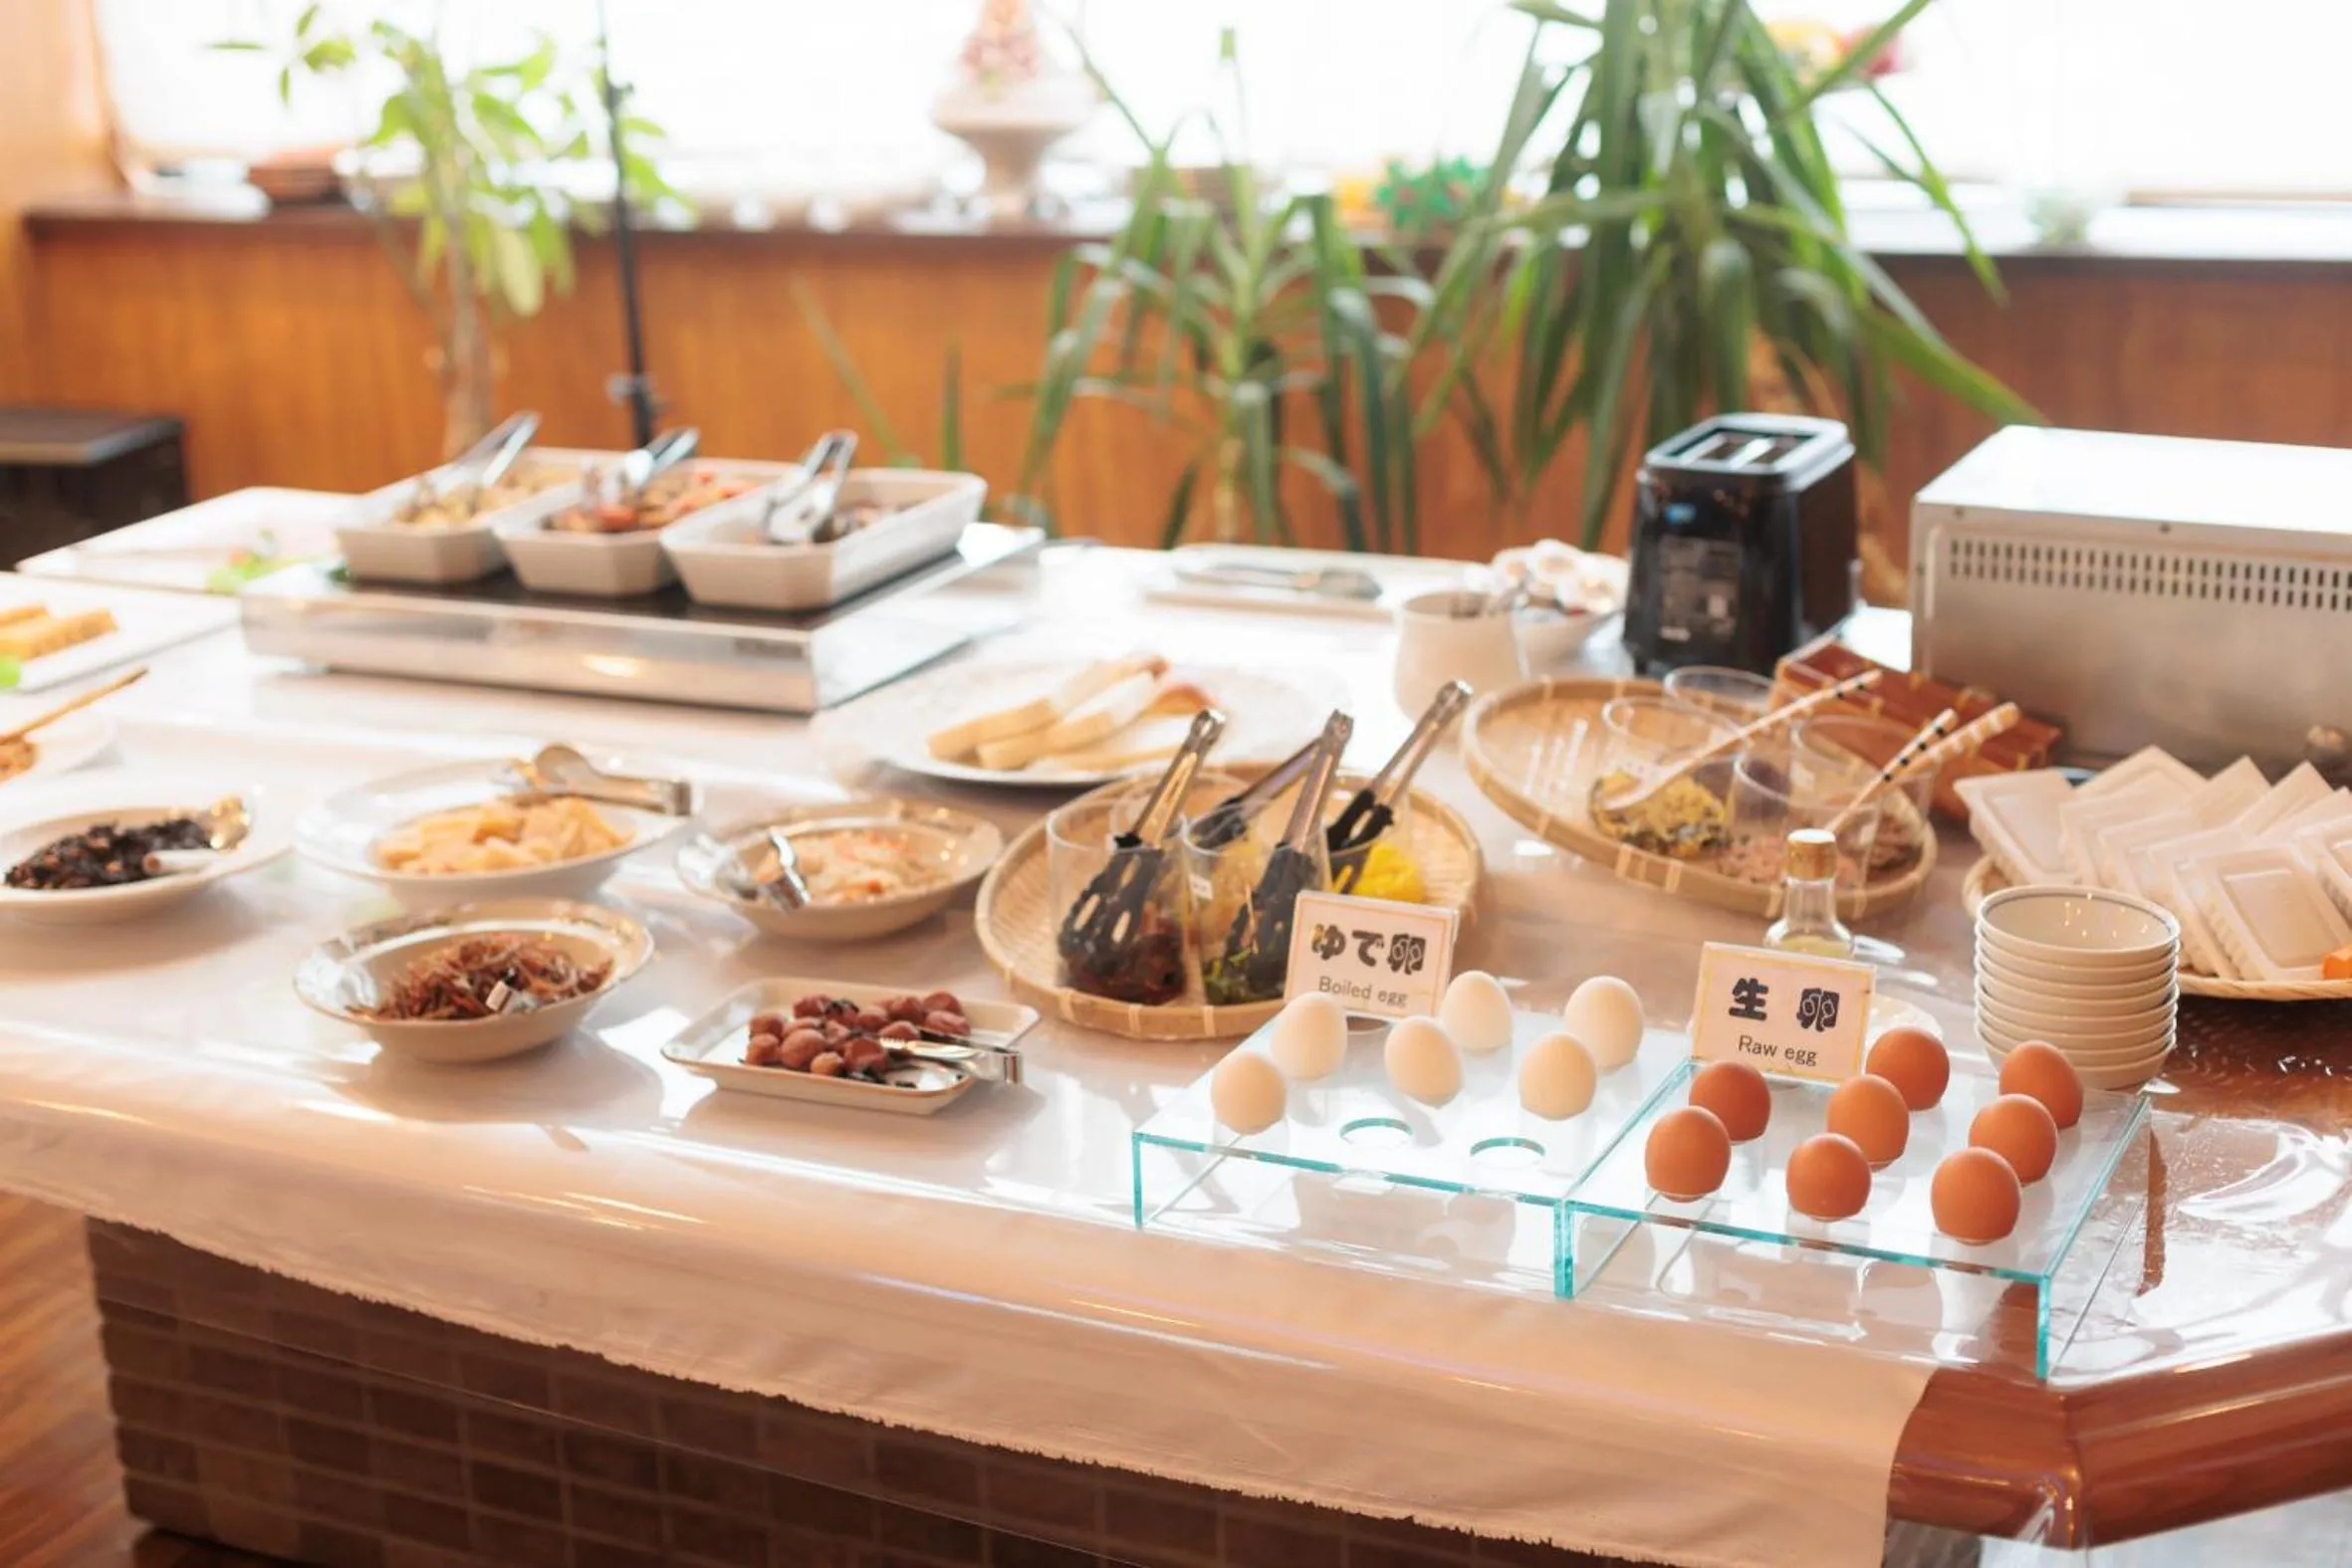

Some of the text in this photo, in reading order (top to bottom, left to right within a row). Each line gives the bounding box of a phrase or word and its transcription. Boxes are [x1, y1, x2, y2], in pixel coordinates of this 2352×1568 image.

[1310, 924, 1426, 975] ゆで卵
[1319, 977, 1408, 1008] Boiled egg
[1738, 1035, 1817, 1066] Raw egg
